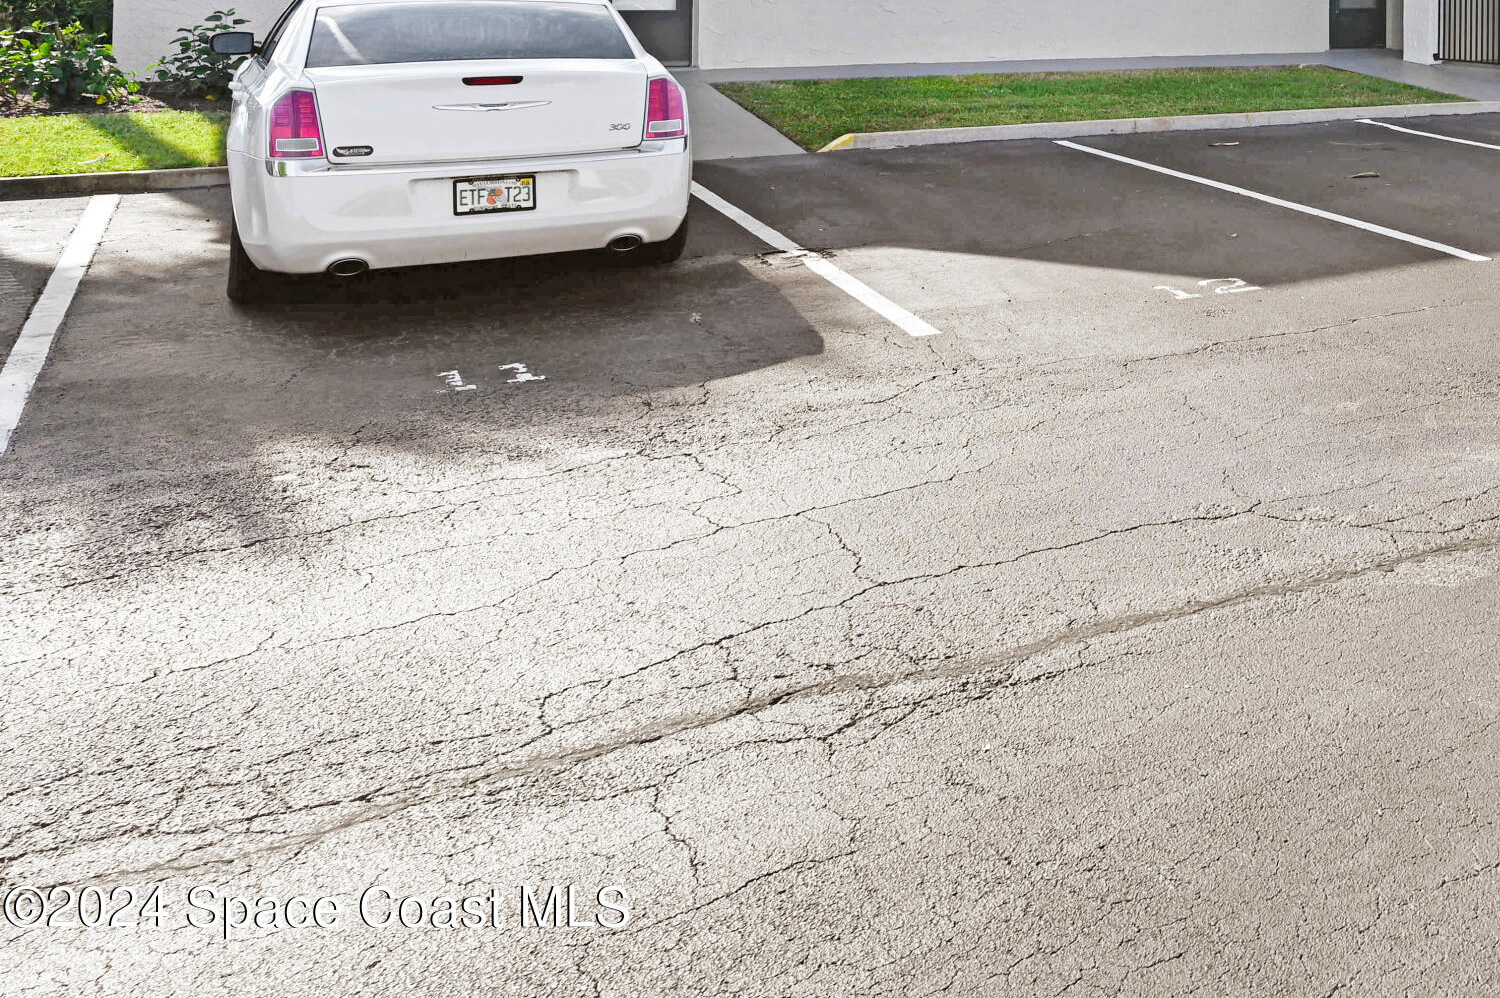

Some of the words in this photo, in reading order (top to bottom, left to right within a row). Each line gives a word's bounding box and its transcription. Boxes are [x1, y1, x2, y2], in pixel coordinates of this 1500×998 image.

[608, 122, 631, 131] 300
[459, 188, 486, 206] ETF
[504, 186, 531, 203] T23
[1153, 277, 1263, 300] 12
